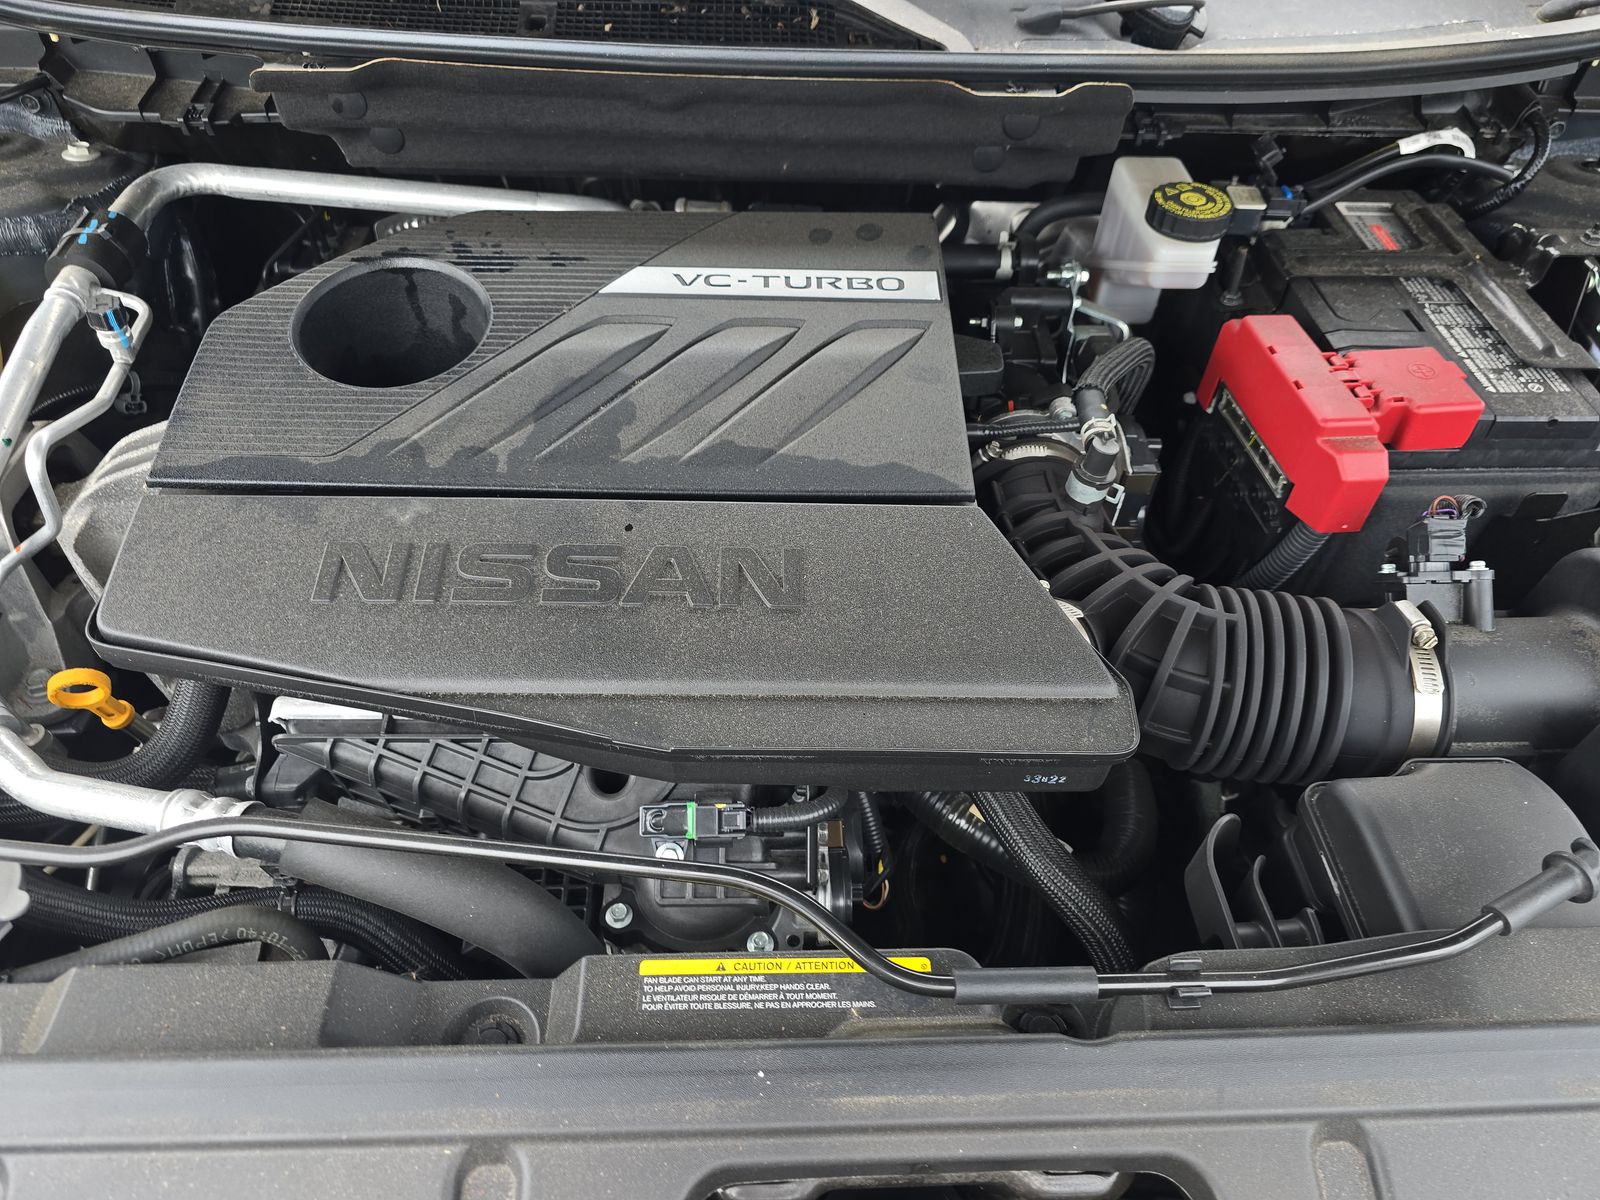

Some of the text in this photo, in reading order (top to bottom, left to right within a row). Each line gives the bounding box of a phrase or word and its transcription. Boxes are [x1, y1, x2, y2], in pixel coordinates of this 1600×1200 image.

[673, 273, 906, 292] VC-TURBO
[310, 541, 805, 609] NISSAN
[733, 962, 782, 971] CAUTION
[795, 961, 854, 970] ATTENTION
[644, 976, 658, 984] FAN
[659, 976, 682, 984] BLADE
[723, 975, 732, 983] AT
[733, 975, 748, 983] ANY
[749, 975, 767, 983] TIME.
[739, 992, 778, 1000] DÉMARRER
[779, 991, 785, 1000] À
[714, 1002, 753, 1010] BLESSURE,
